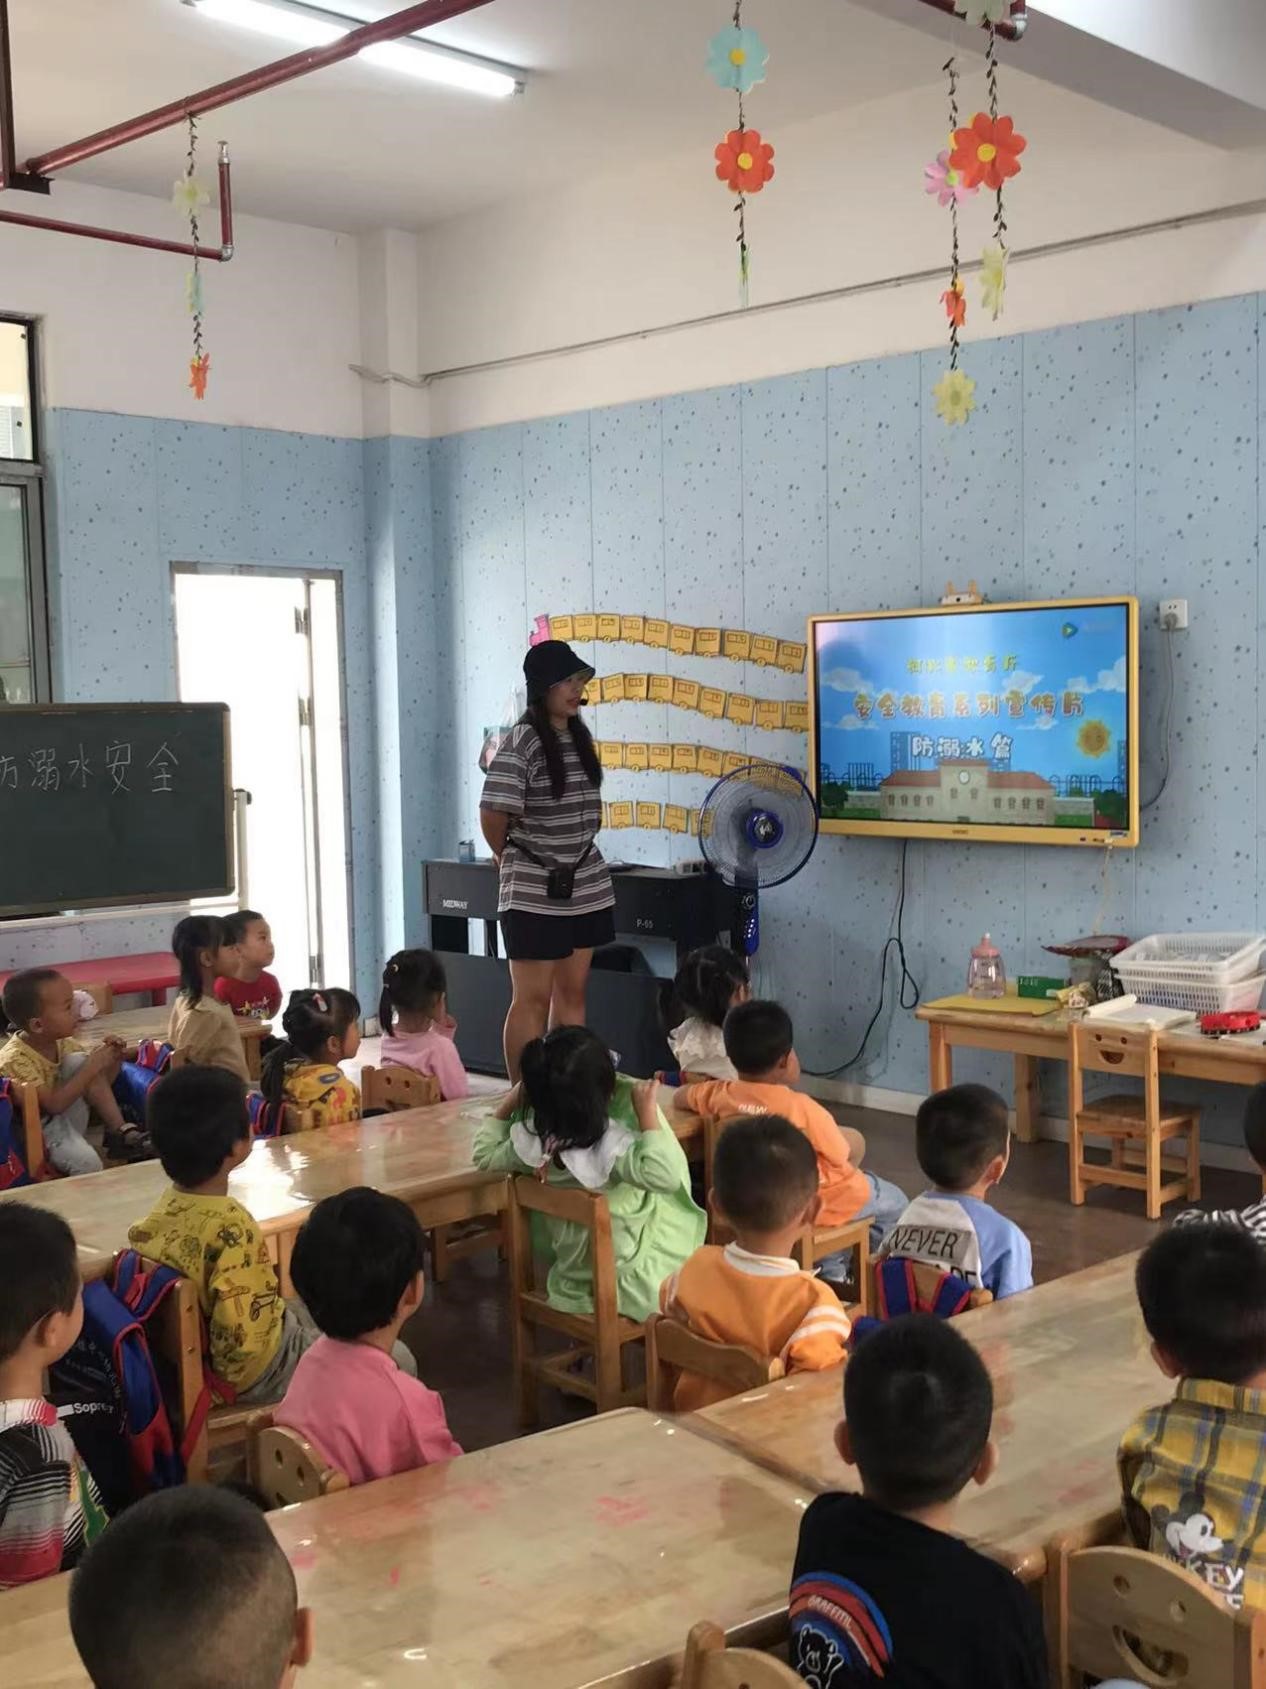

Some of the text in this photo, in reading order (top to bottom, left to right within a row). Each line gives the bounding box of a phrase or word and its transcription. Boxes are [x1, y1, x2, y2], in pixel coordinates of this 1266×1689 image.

[853, 690, 1084, 719] 安全教育系列宣传片
[911, 733, 1012, 758] 防溺水篇
[888, 1227, 960, 1260] NEVER
